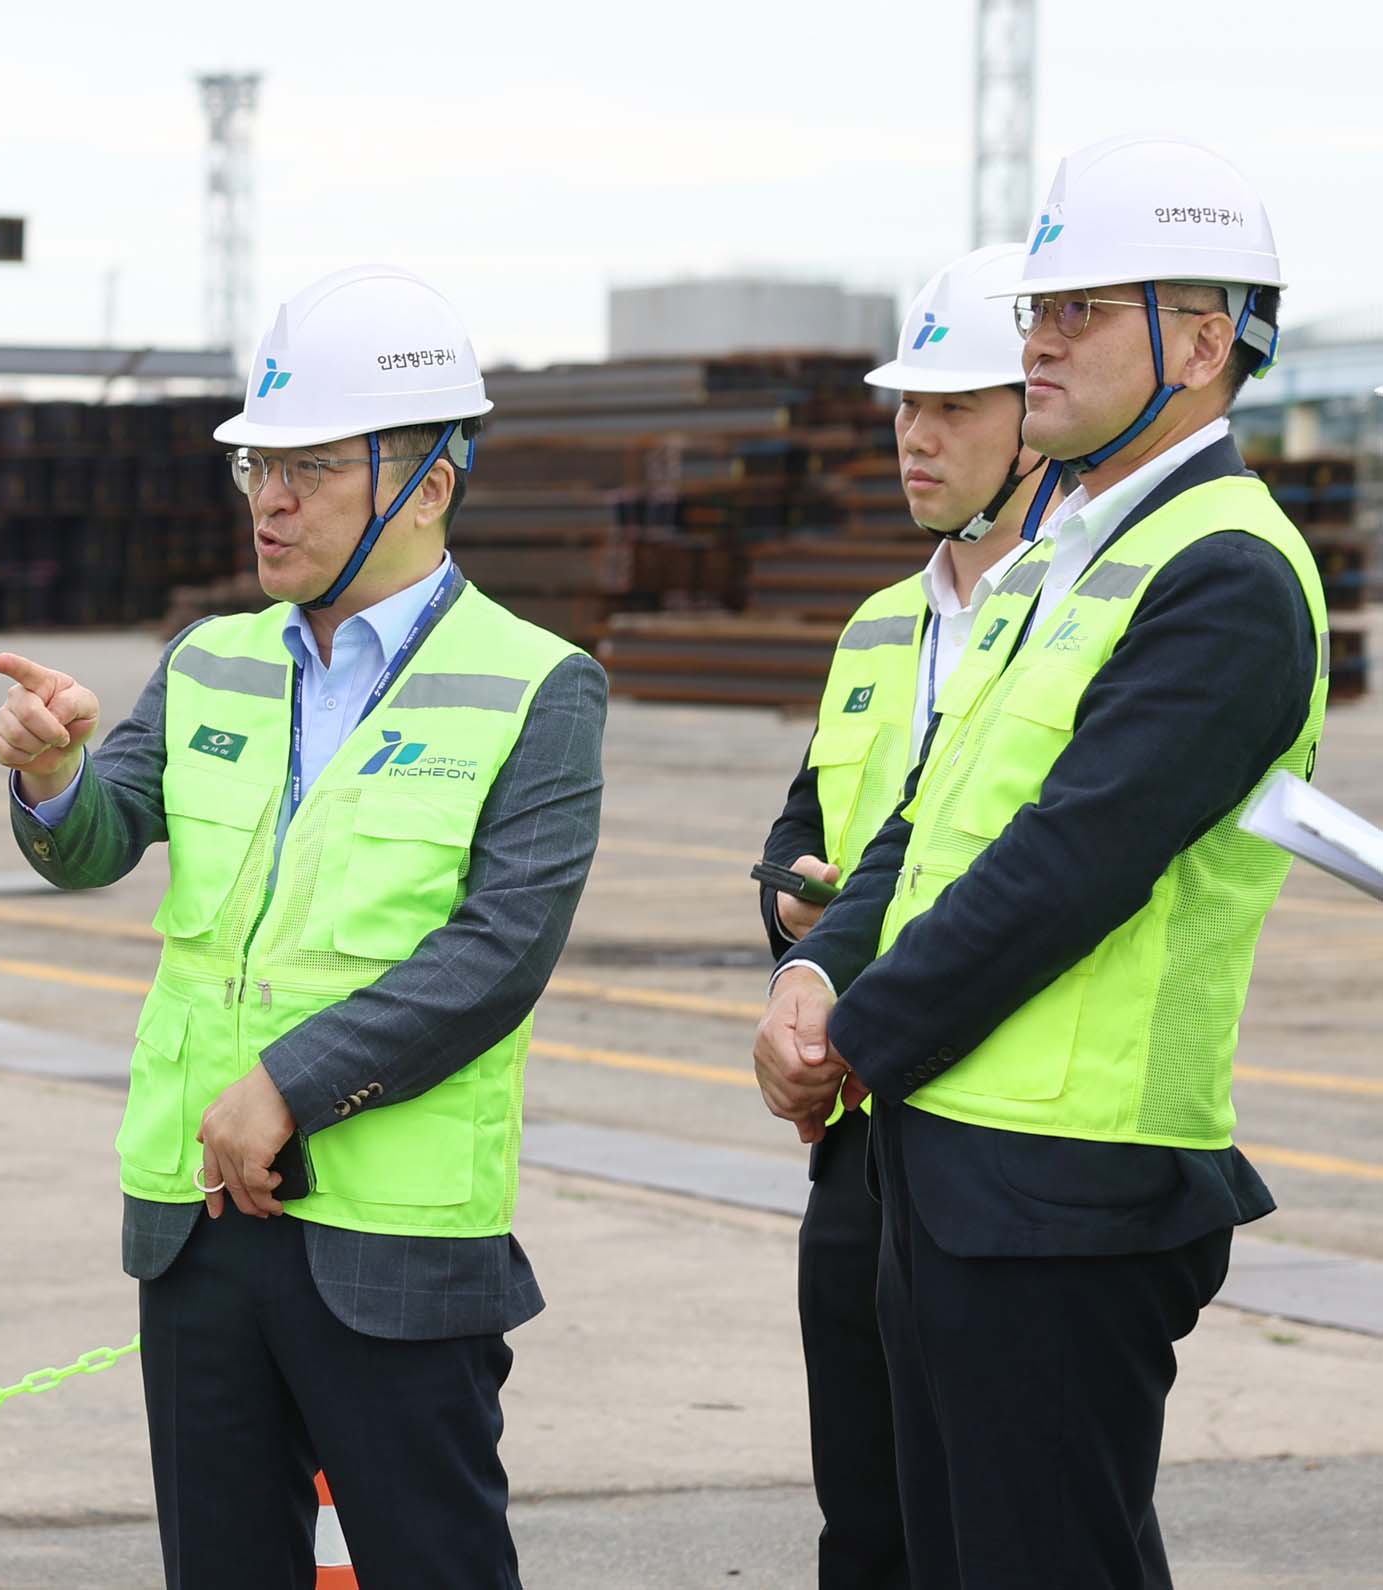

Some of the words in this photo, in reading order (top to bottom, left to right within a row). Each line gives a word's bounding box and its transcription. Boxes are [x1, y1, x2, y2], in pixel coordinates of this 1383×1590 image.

[1155, 207, 1244, 228] 인천항만공사
[377, 349, 456, 371] 인천항만공사
[388, 767, 476, 781] INCHEON
